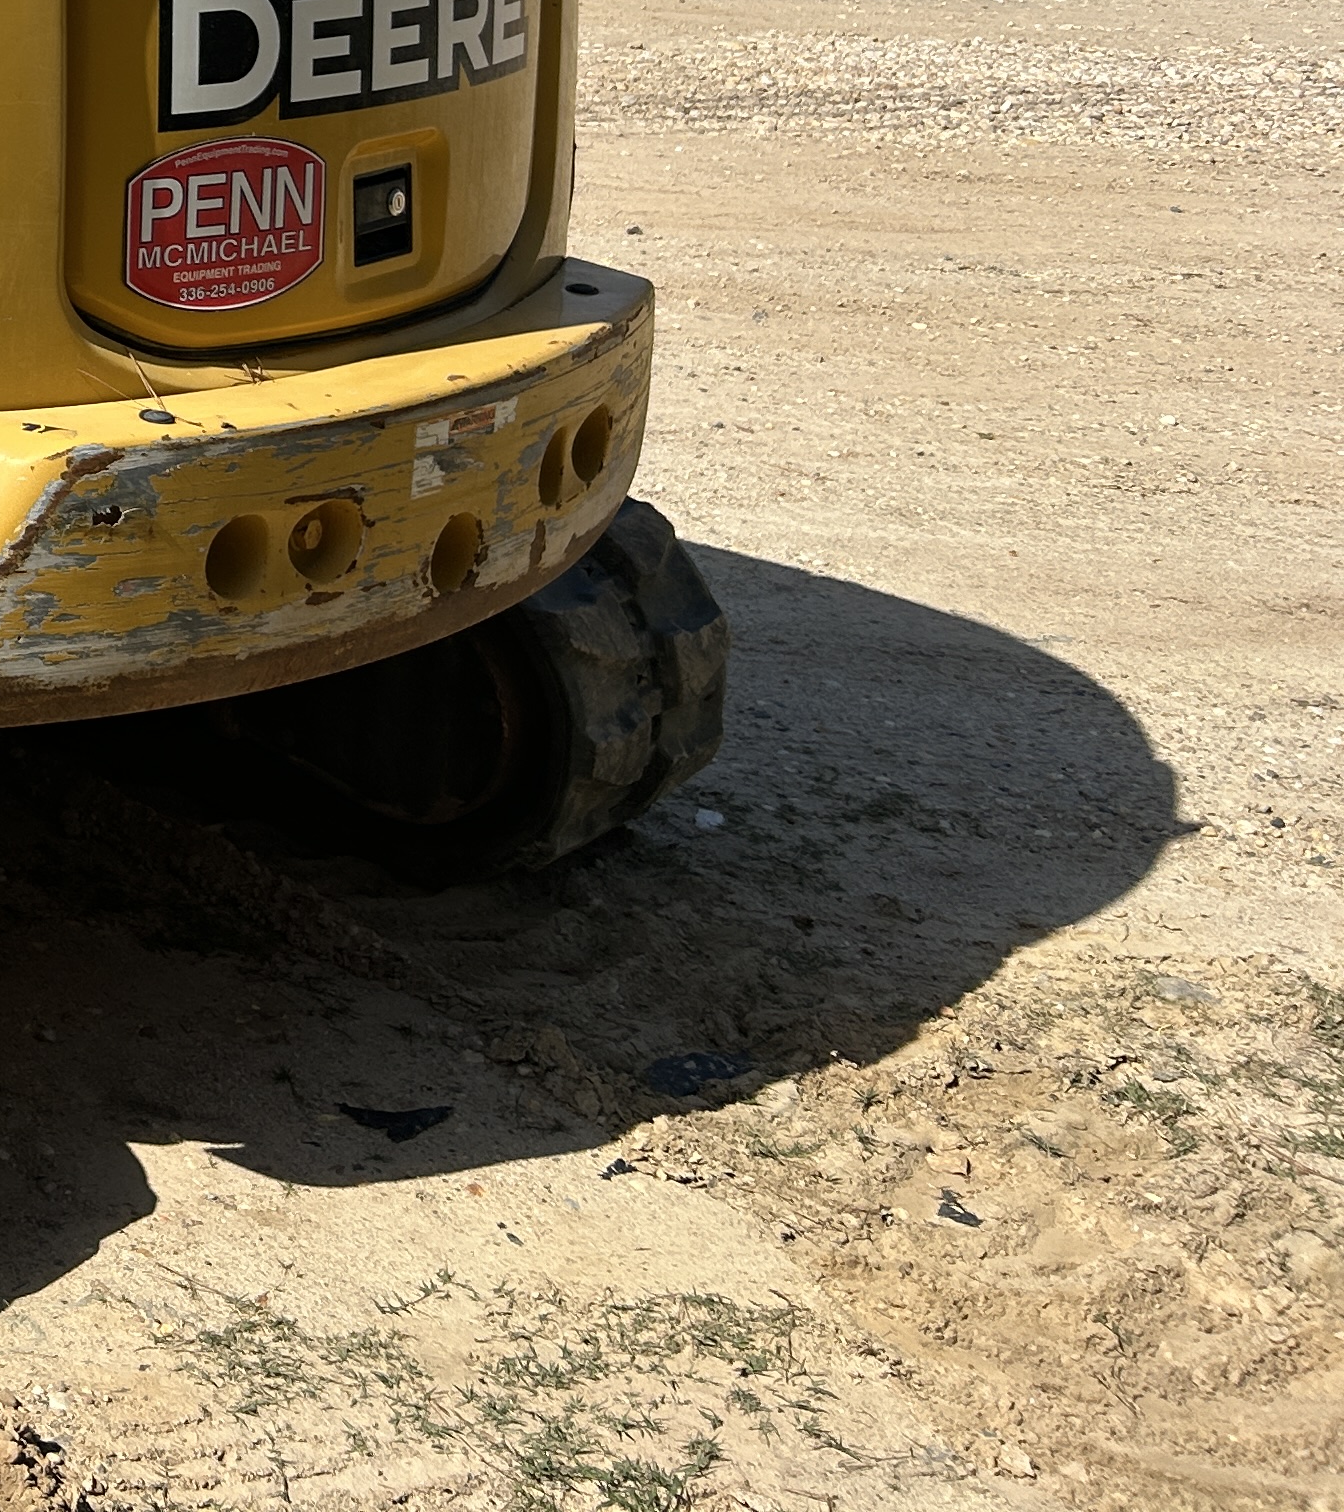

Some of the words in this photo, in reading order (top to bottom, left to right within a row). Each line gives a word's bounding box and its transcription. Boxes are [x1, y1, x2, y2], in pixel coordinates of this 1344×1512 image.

[140, 162, 315, 243] PENN
[136, 229, 313, 270] MCMICHAEL
[172, 266, 235, 284] EQUIPMENT
[238, 260, 282, 276] TRADING
[178, 277, 276, 302] 336-254-0906
